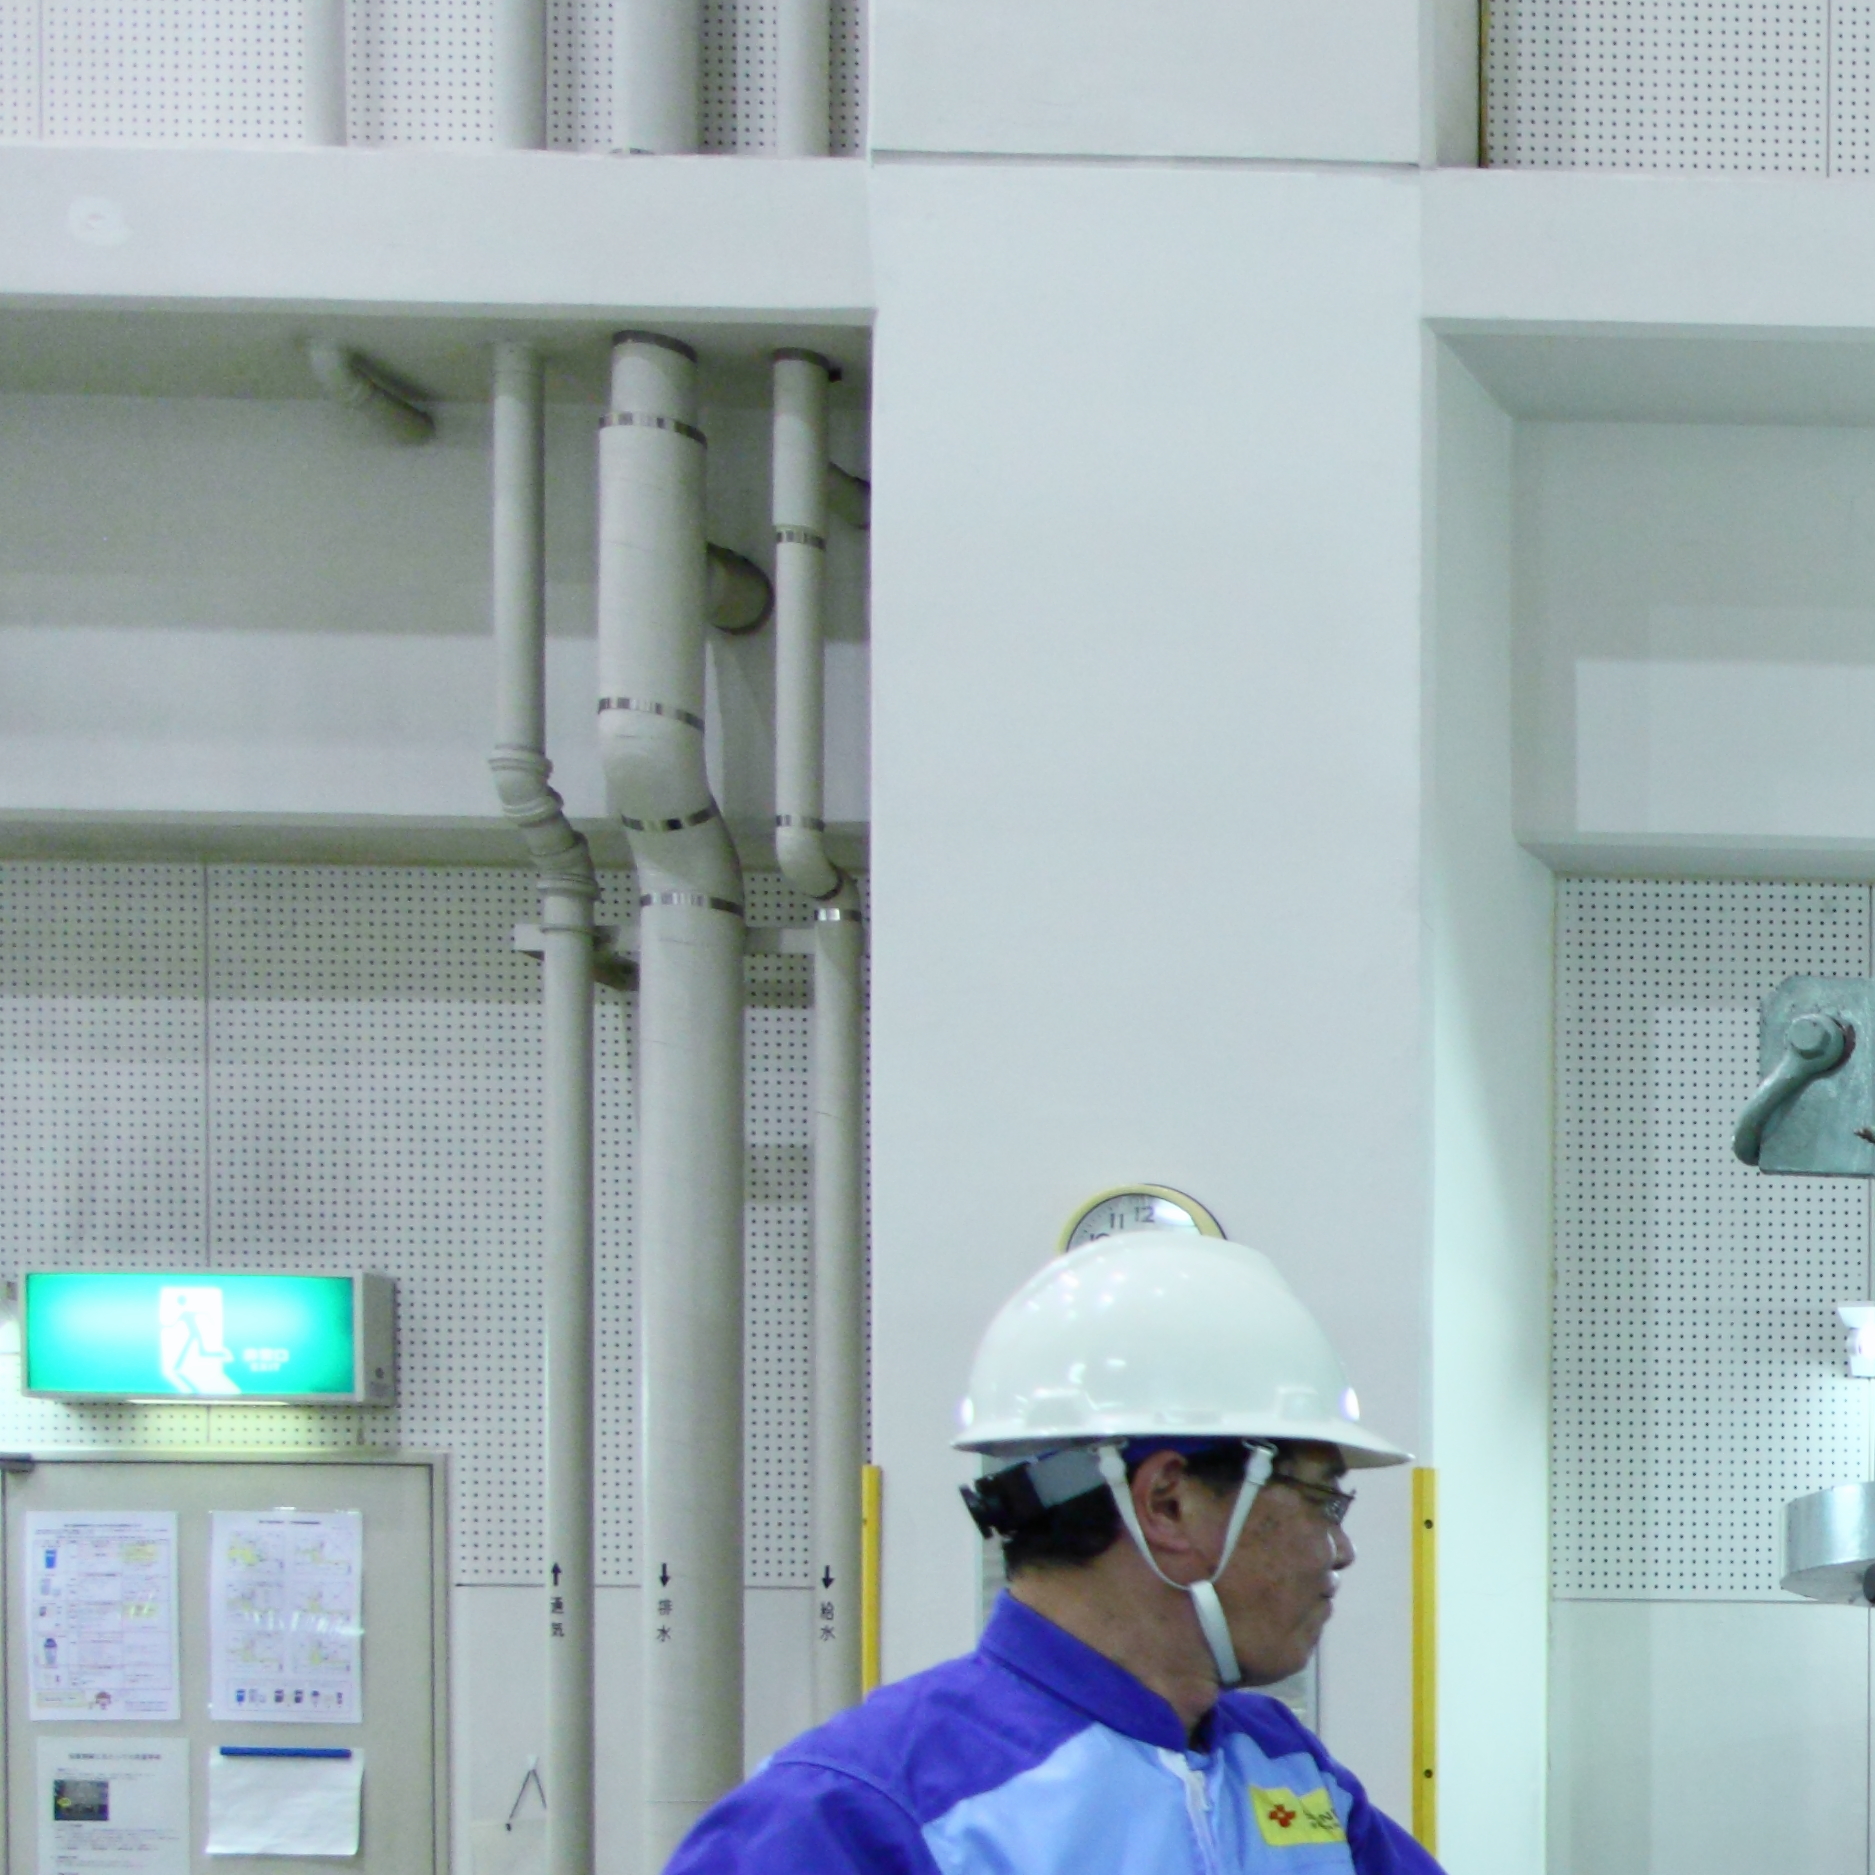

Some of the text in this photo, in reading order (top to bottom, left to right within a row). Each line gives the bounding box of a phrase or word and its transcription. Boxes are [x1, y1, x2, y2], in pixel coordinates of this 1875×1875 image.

[1109, 1212, 1125, 1230] 11
[1134, 1205, 1155, 1223] 12
[657, 1598, 673, 1643] 排水
[819, 1601, 836, 1643] 給水
